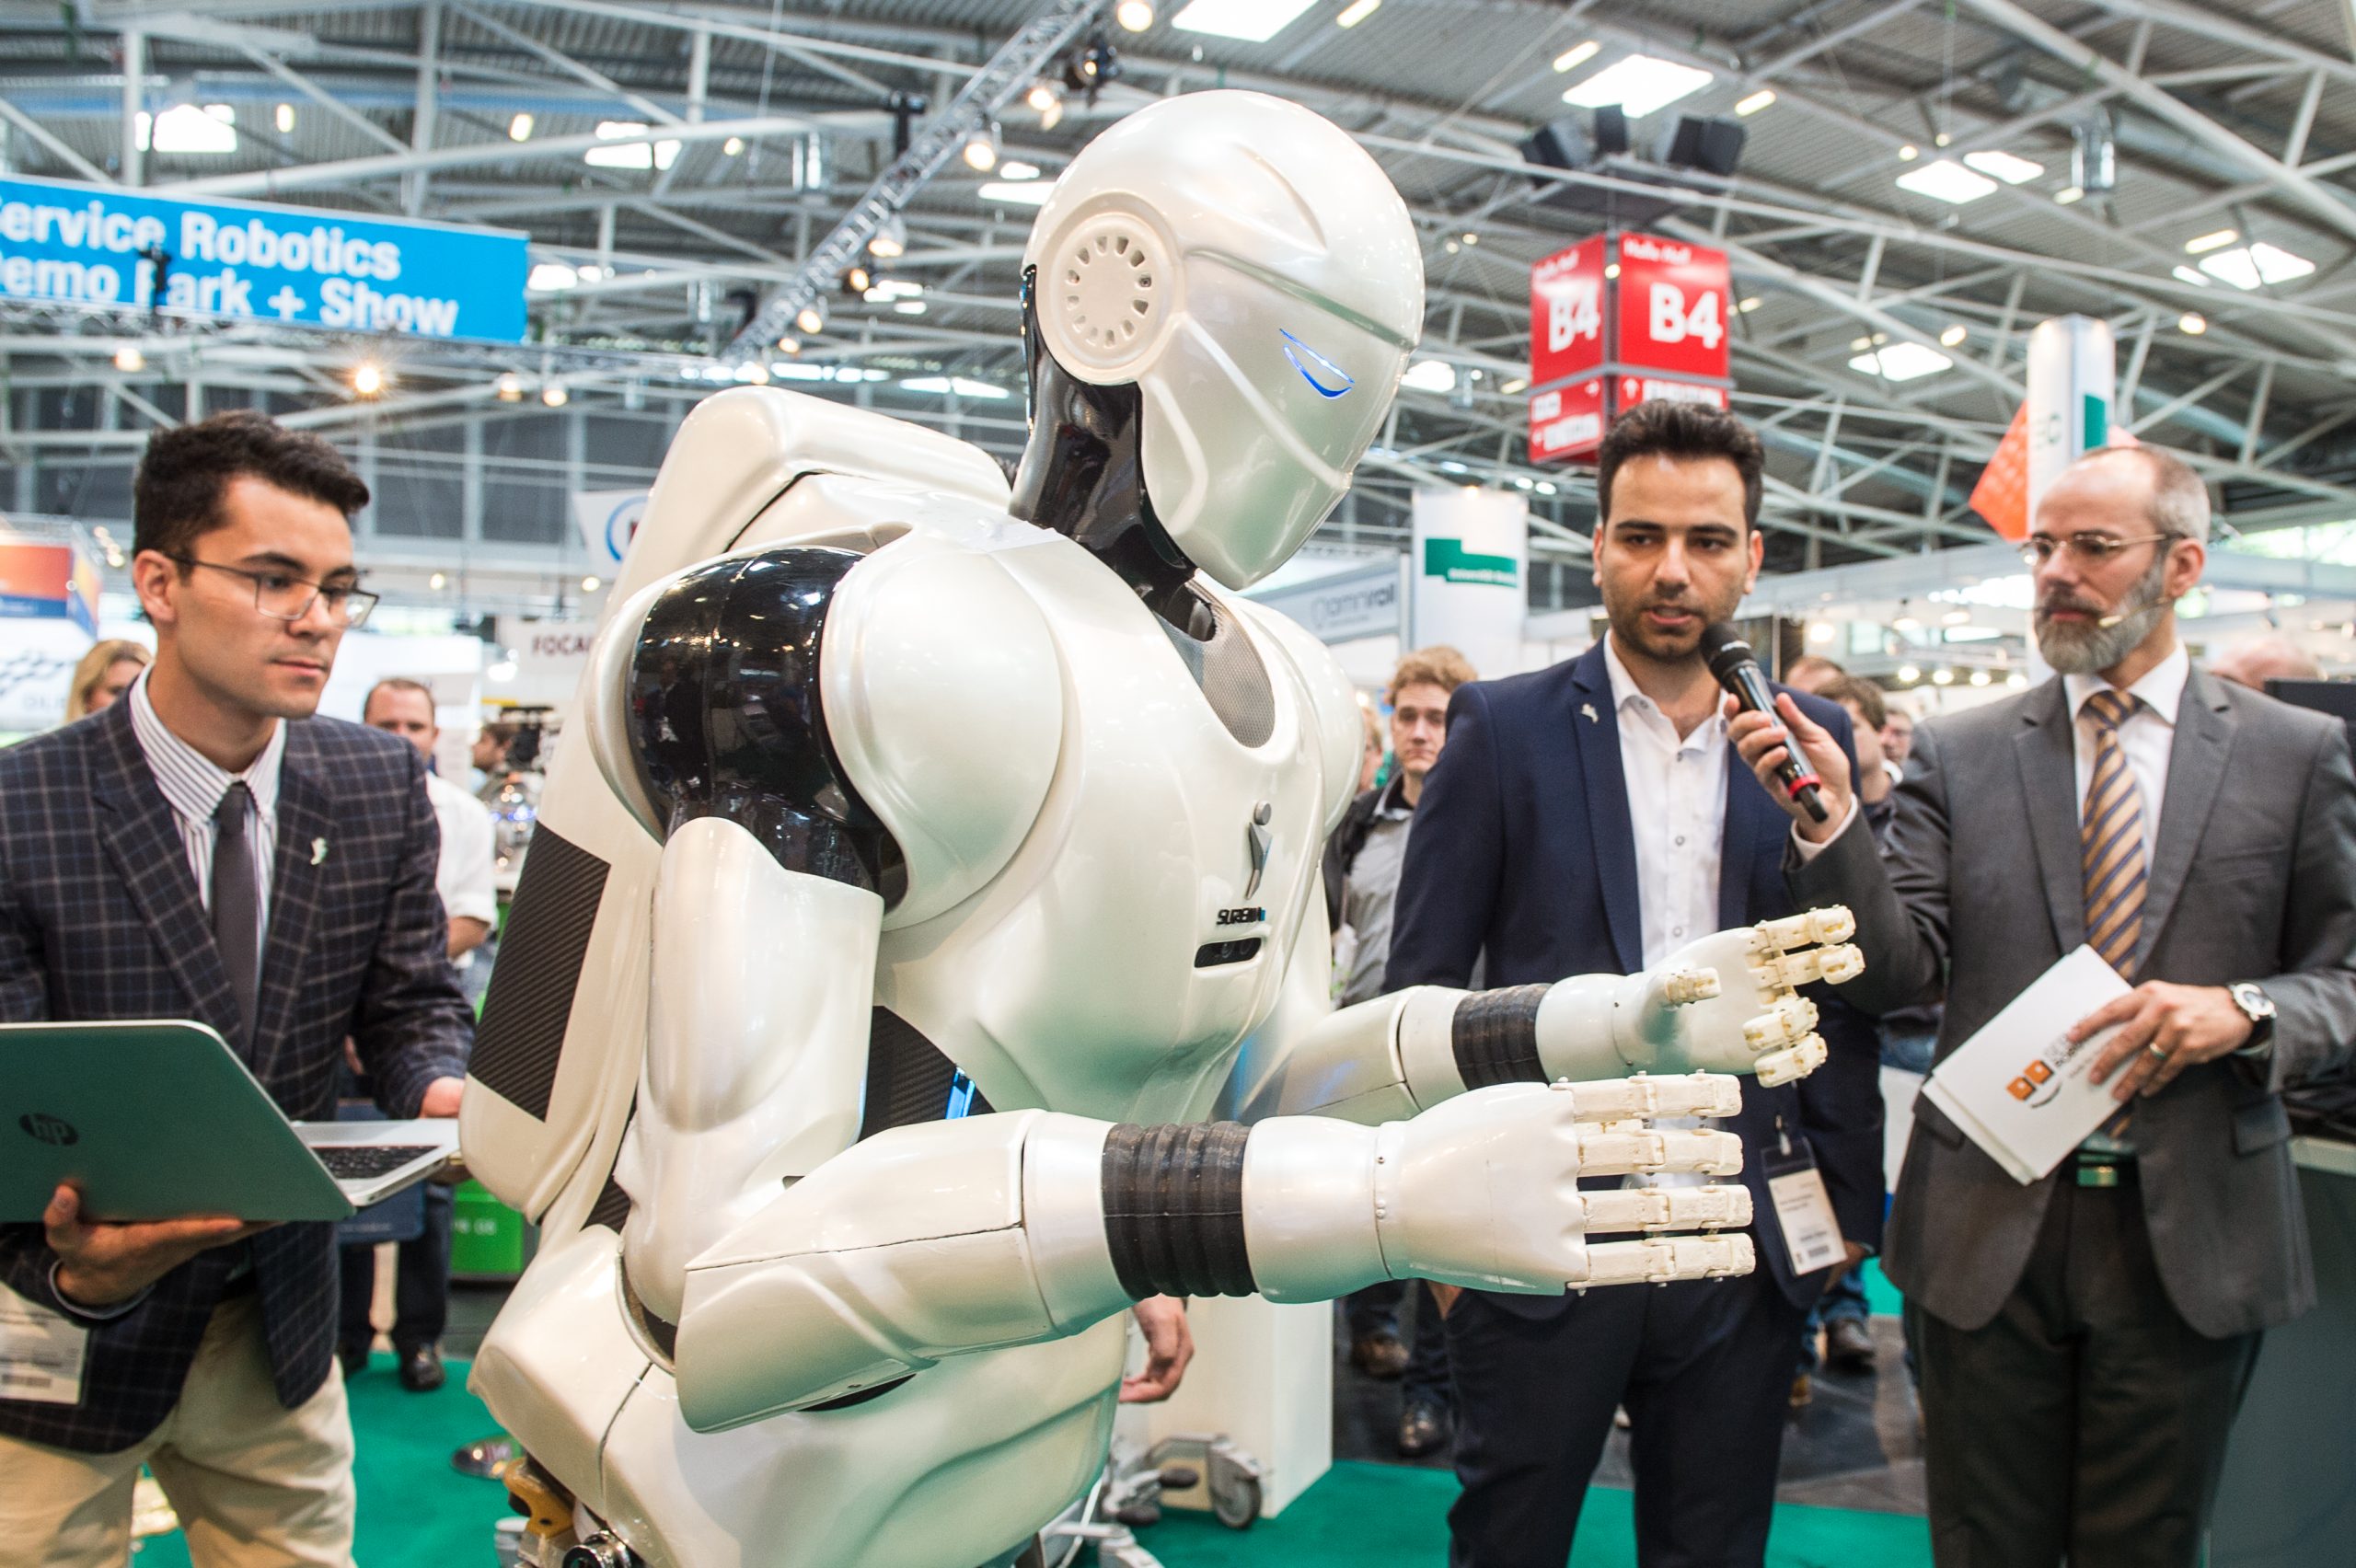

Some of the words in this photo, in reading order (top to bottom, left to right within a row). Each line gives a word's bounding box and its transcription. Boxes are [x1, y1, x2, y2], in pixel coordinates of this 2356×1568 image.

[0, 197, 166, 253] ervice
[180, 211, 401, 282] Robotics
[0, 250, 121, 302] emo
[268, 284, 306, 321] +
[320, 276, 458, 338] Show
[1549, 280, 1600, 353] B4
[1648, 282, 1723, 350] B4
